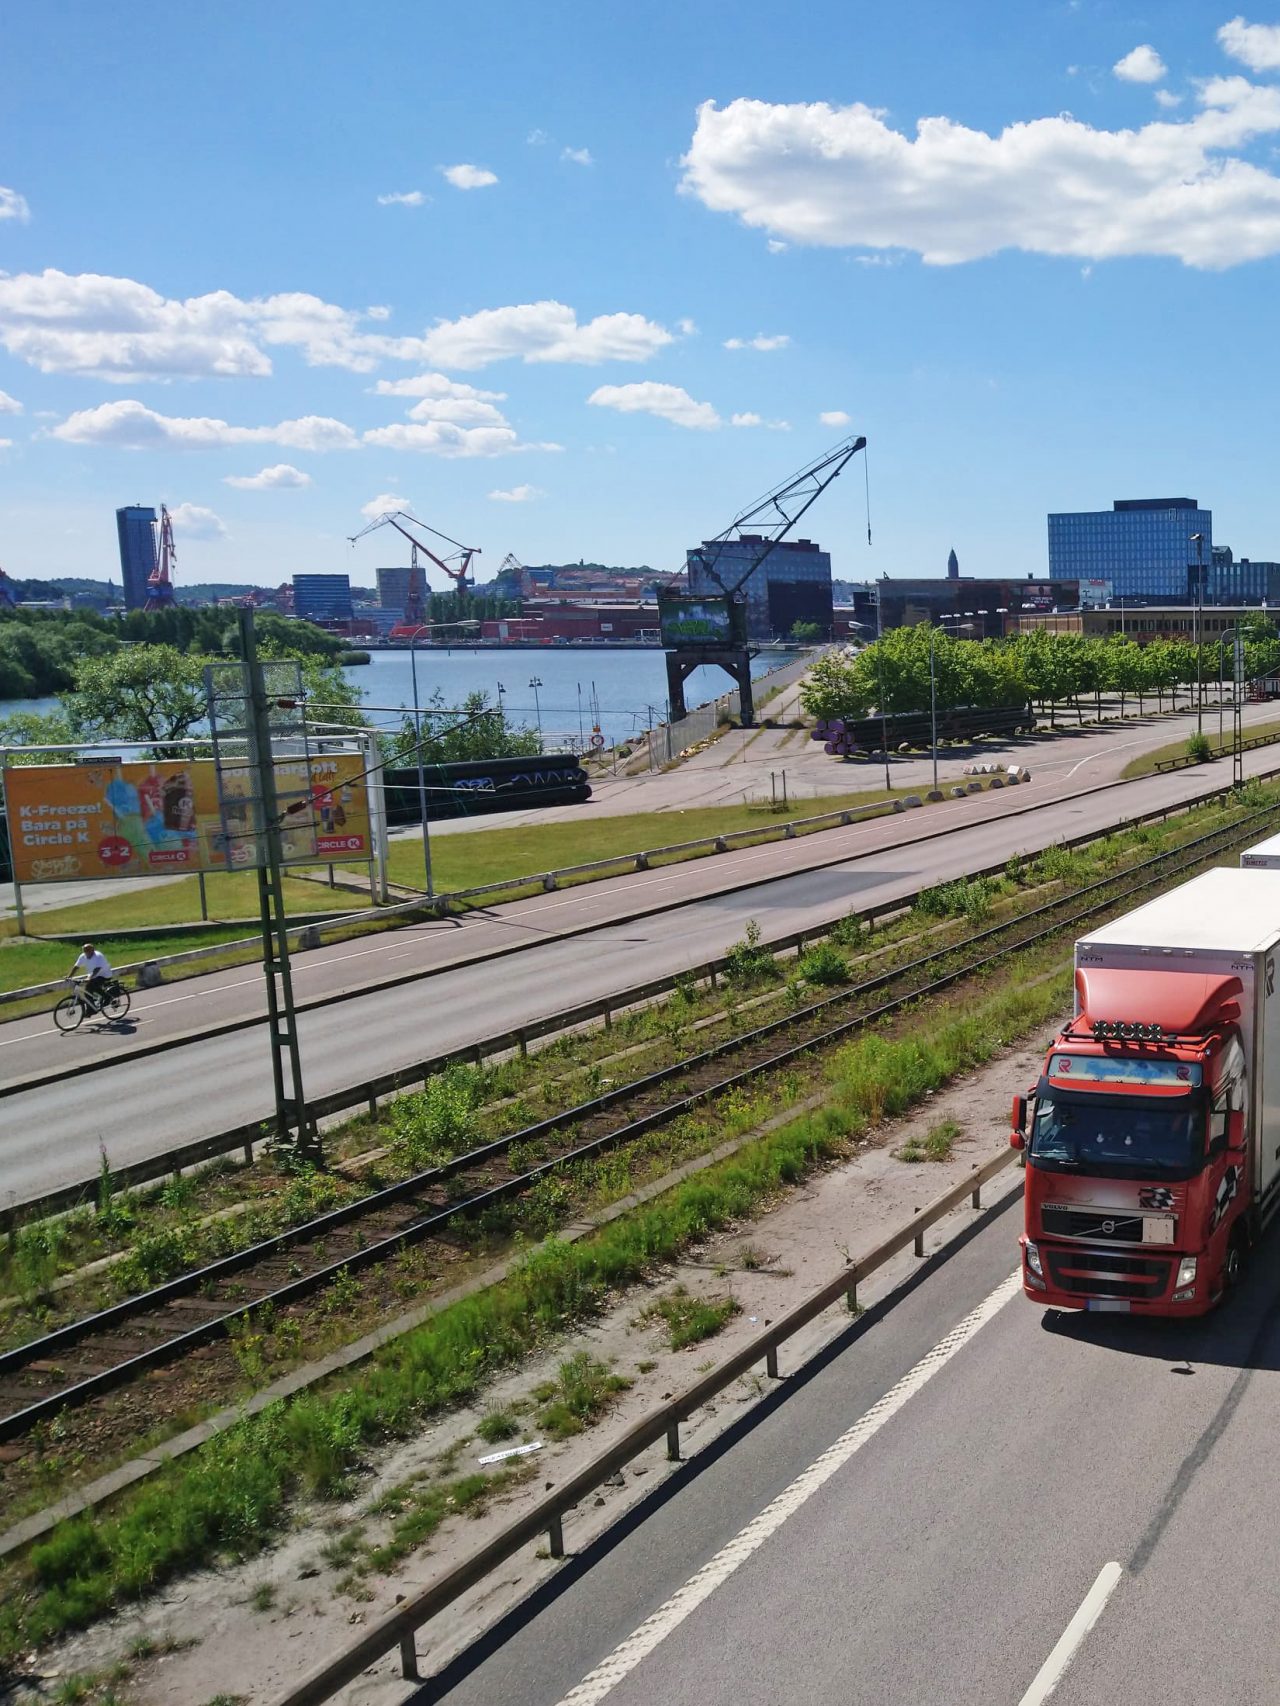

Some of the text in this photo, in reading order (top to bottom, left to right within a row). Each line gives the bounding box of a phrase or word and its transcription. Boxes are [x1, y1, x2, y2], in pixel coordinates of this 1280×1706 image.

[20, 802, 102, 817] K-Freeze!
[21, 818, 87, 832] Bara på
[23, 832, 89, 846] Circle K
[317, 840, 347, 849] CIRCLE
[120, 846, 130, 856] 2
[1265, 957, 1275, 999] R
[1058, 1058, 1073, 1073] R
